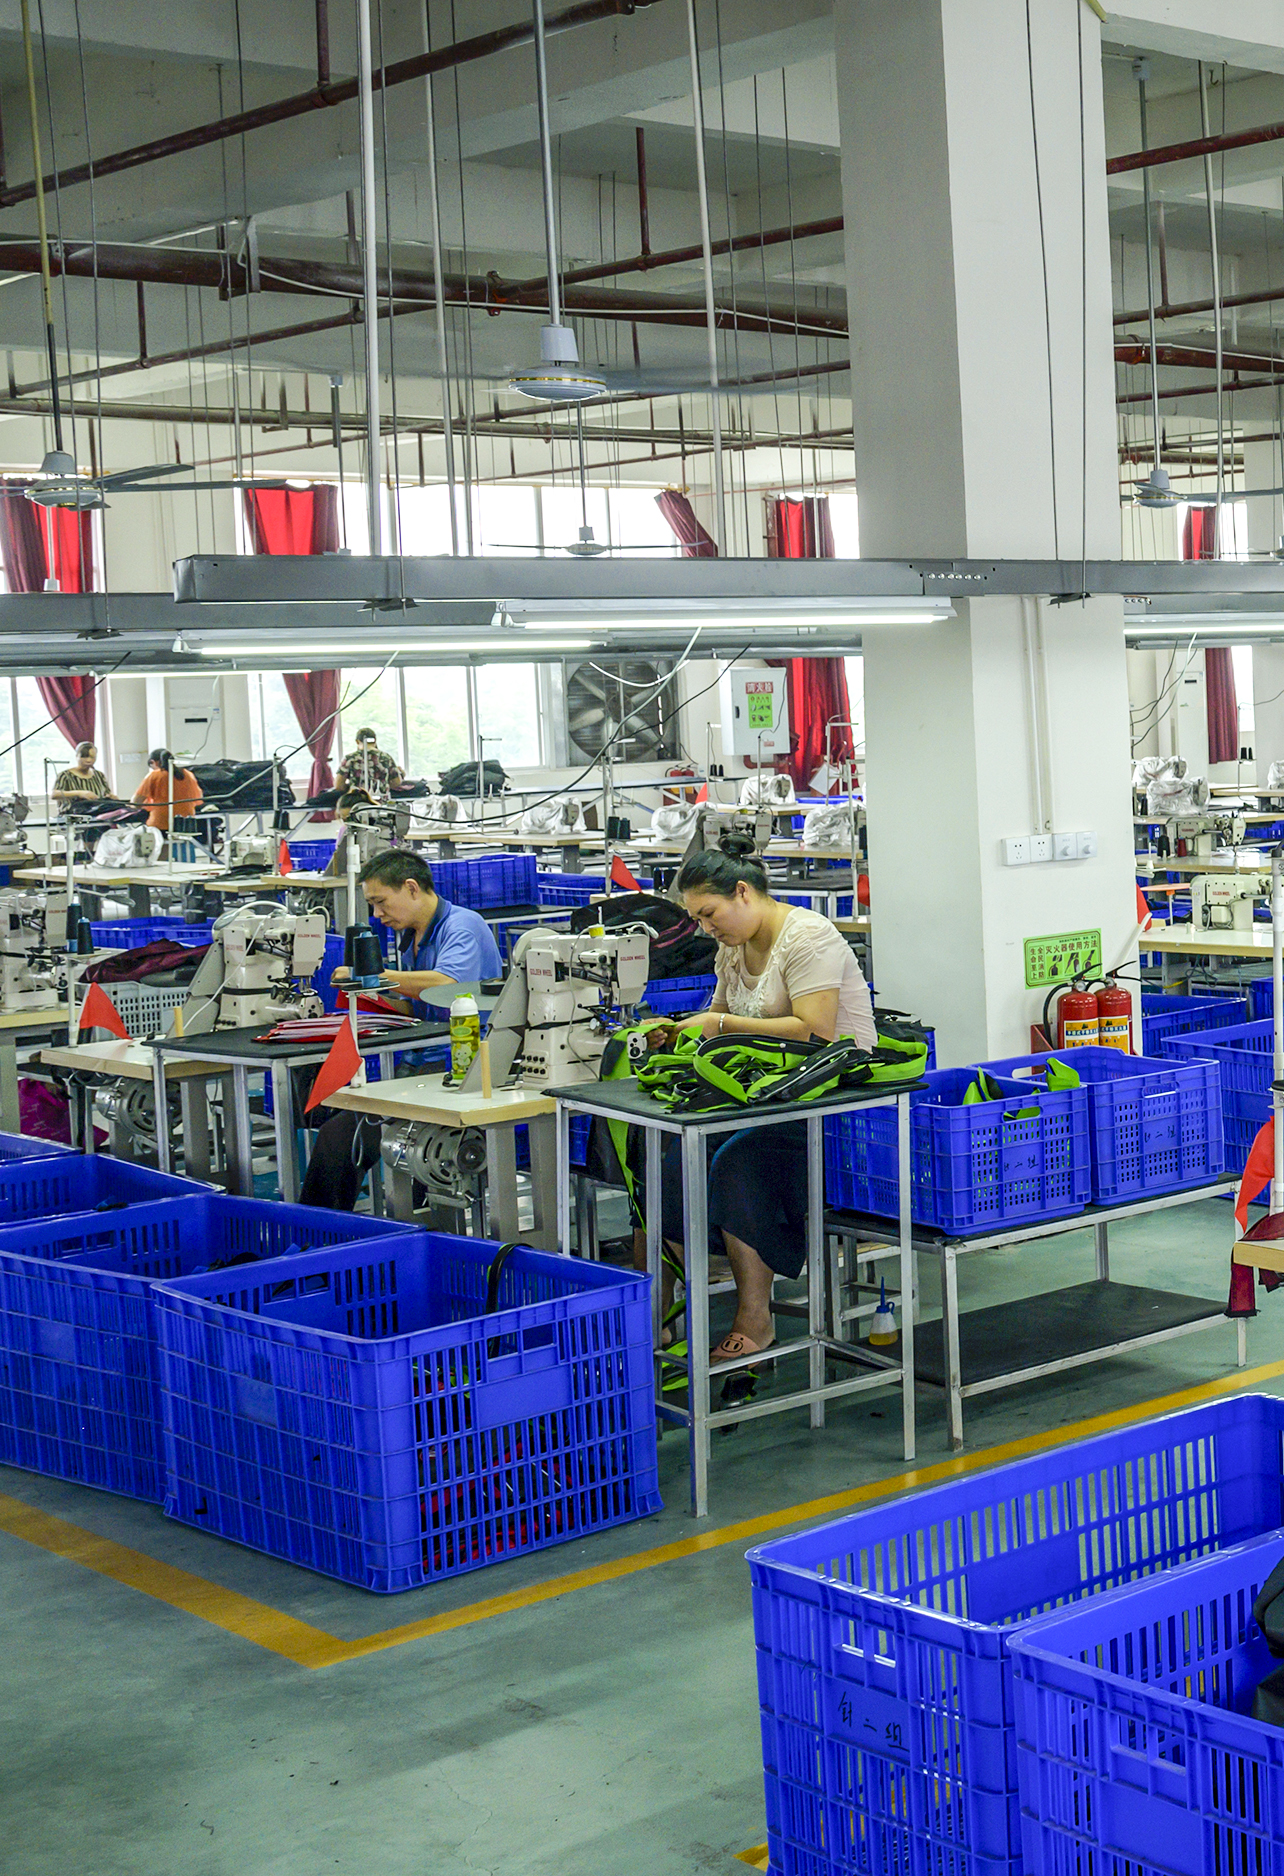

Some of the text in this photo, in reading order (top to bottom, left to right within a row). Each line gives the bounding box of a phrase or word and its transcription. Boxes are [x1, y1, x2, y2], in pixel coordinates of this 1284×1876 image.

[1045, 939, 1098, 954] 灭火器使用方法
